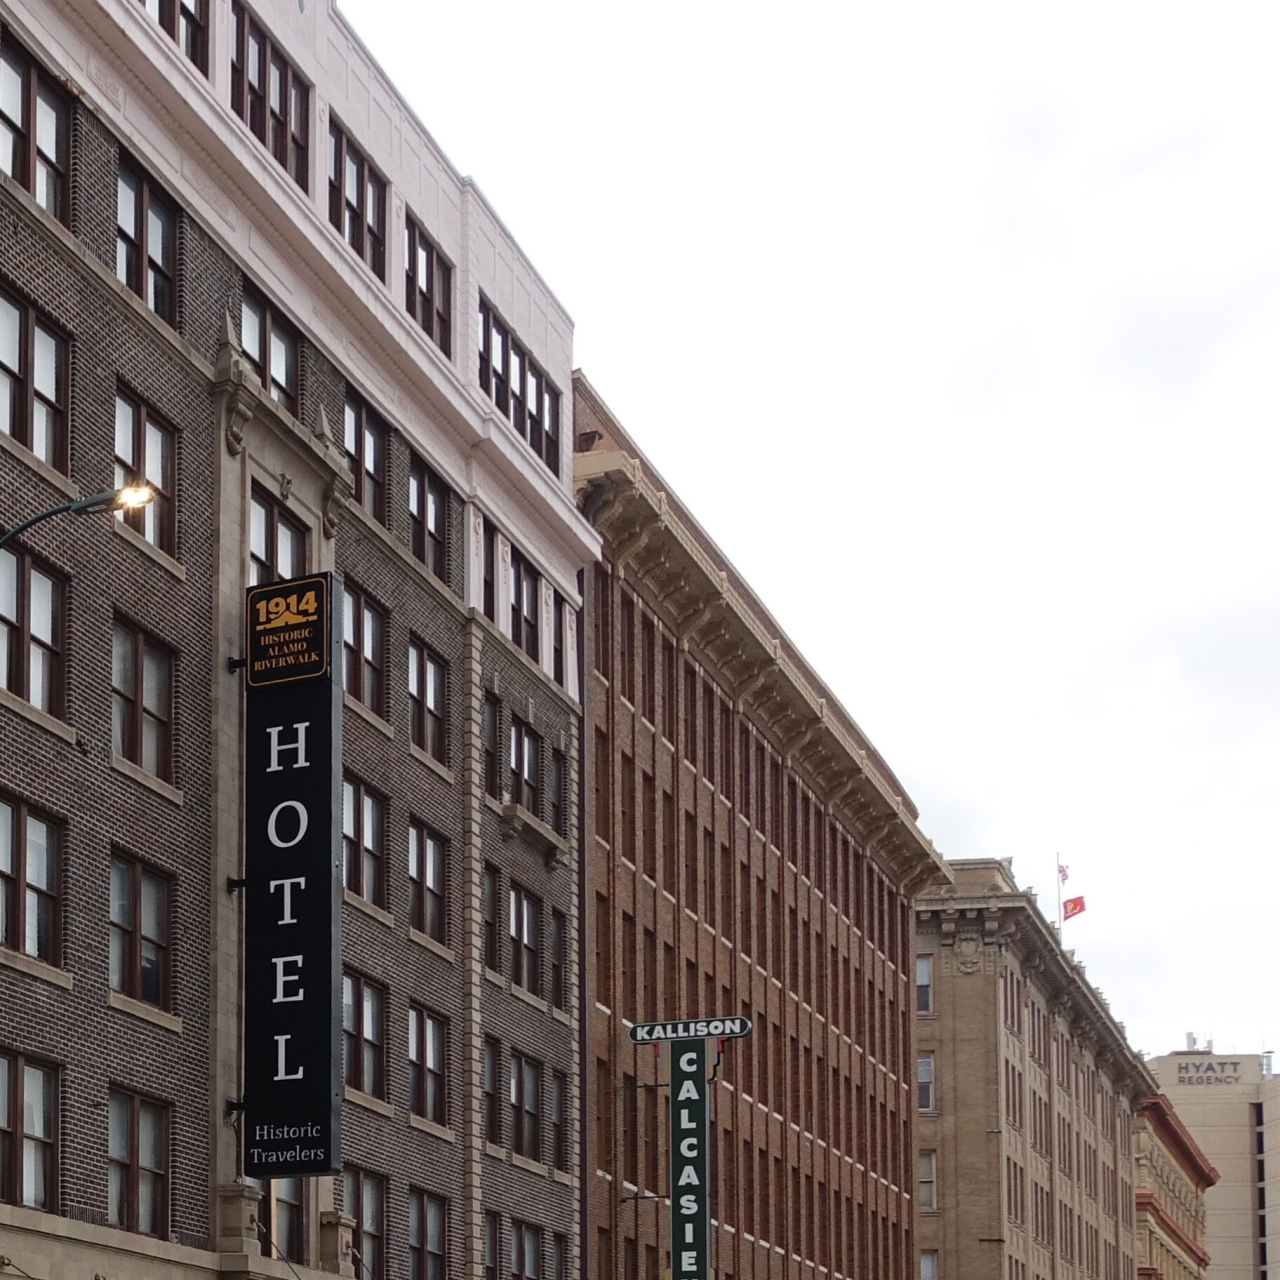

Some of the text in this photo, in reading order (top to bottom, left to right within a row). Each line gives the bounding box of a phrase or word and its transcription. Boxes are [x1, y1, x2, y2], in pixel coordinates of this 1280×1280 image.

[256, 590, 317, 623] 1914
[260, 628, 313, 646] HISTORIC
[267, 641, 306, 656] ALAMO
[254, 651, 319, 671] RIVERWALK
[266, 722, 310, 1081] HOTEL
[636, 1019, 741, 1040] KALLISON
[1178, 1062, 1241, 1074] HYATT
[1178, 1075, 1241, 1085] REGENCY
[255, 1122, 321, 1140] Historic
[250, 1146, 324, 1164] Travelers
